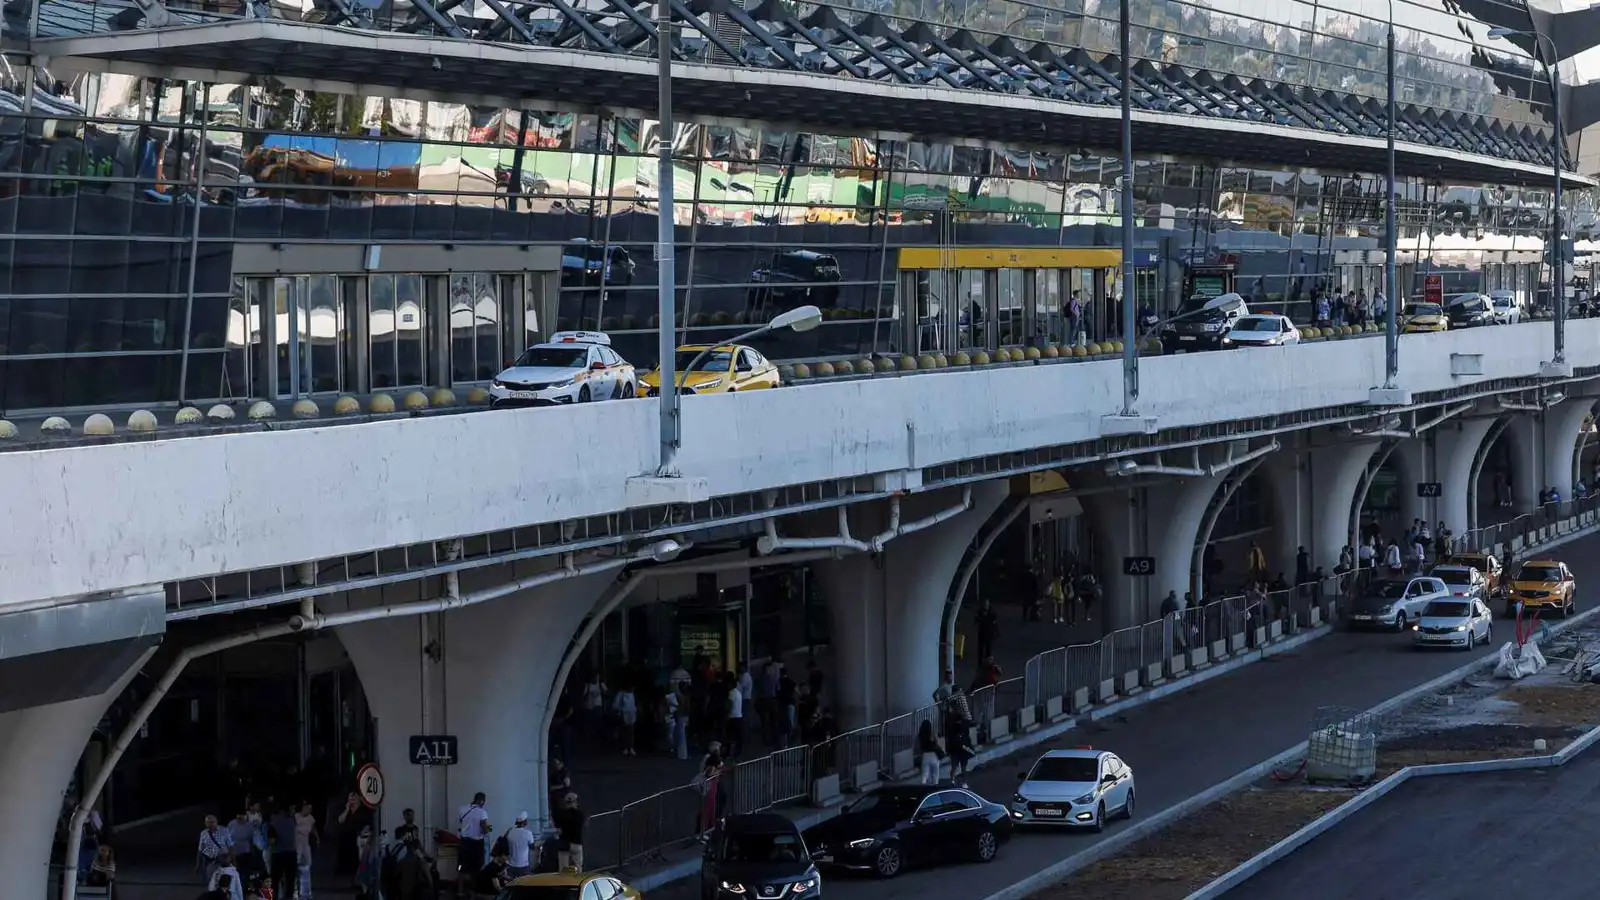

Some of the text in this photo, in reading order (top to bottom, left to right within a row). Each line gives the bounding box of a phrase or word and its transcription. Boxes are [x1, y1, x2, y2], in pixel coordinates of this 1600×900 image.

[1129, 559, 1150, 573] A9
[416, 741, 452, 760] A11
[366, 776, 378, 795] 20
